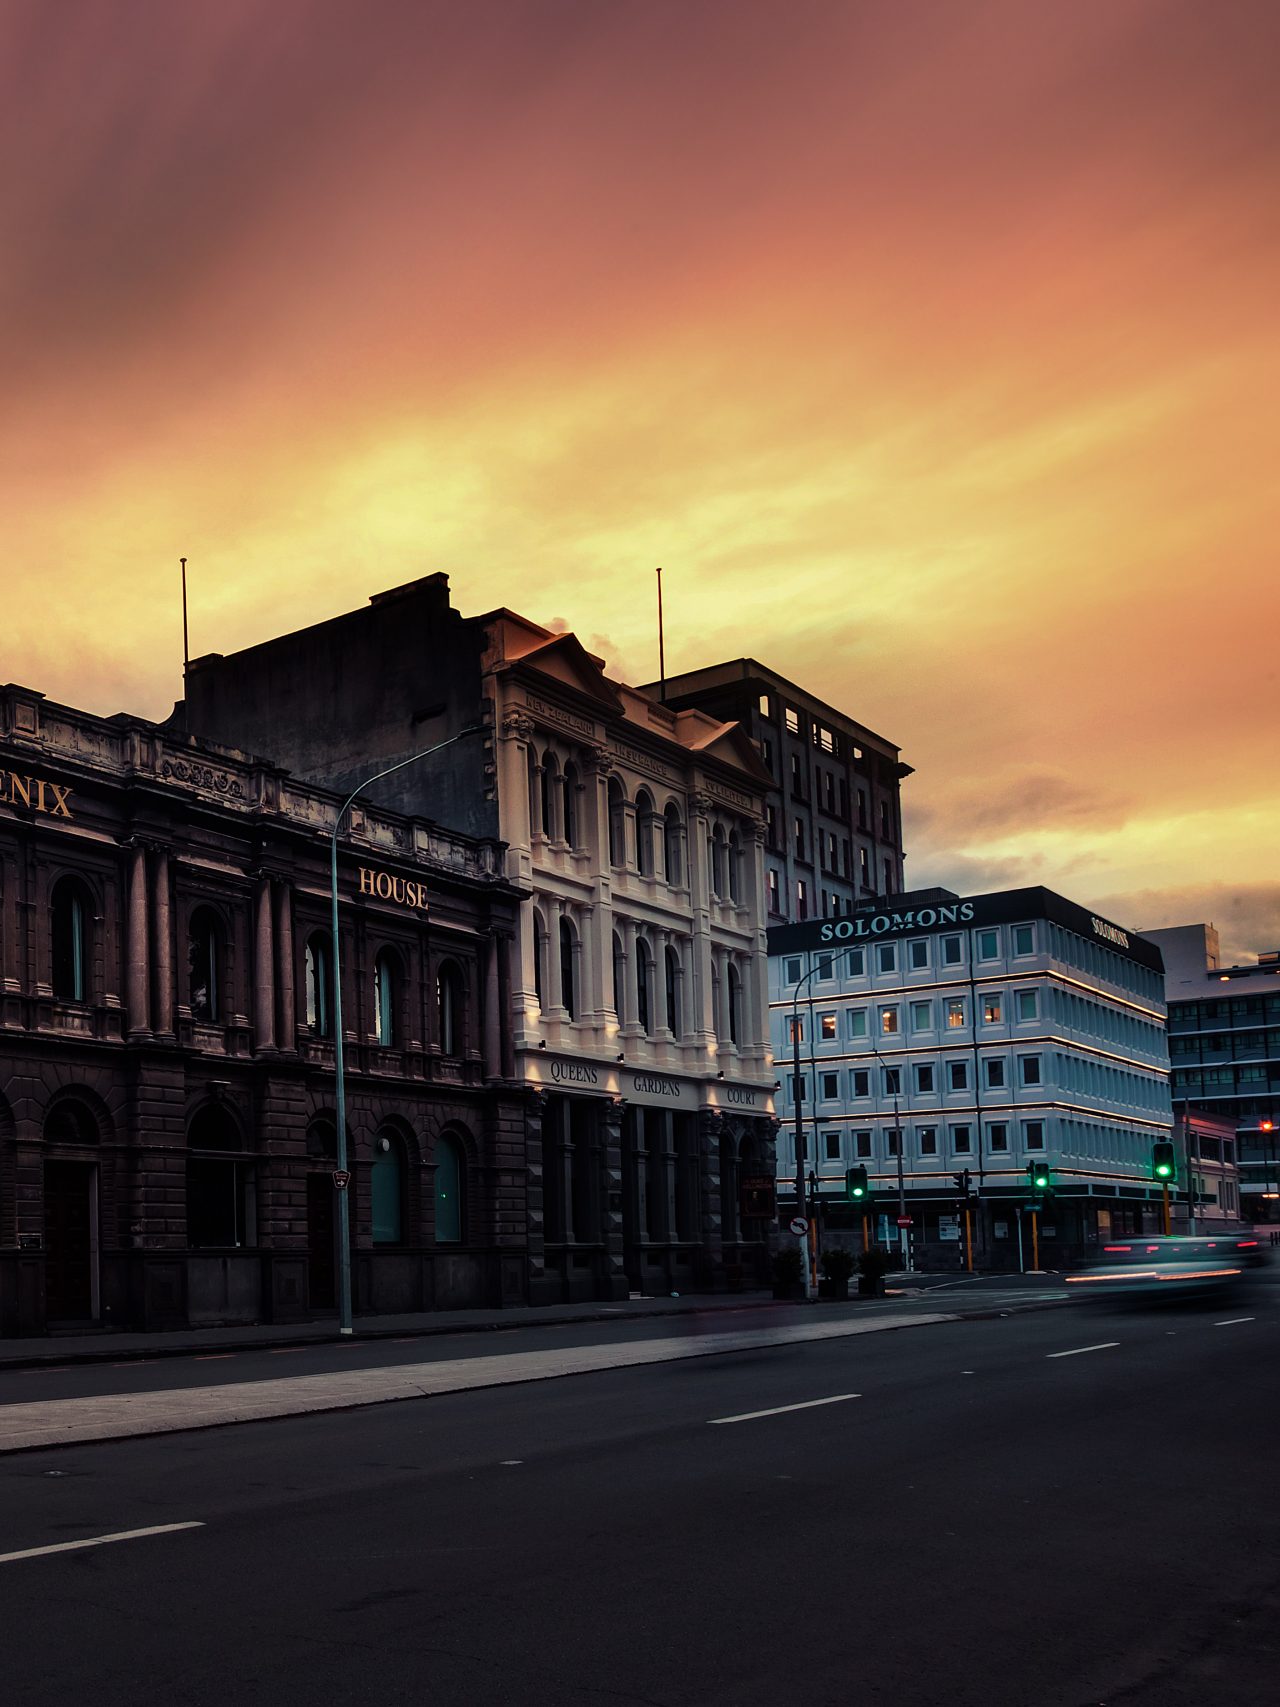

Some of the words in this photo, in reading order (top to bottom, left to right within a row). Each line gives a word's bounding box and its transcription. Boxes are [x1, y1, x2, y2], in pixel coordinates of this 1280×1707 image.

[358, 866, 430, 911] HOUSE
[819, 902, 975, 942] SOLOMONS
[1091, 916, 1130, 949] SOLOMONS
[550, 1060, 598, 1085] QUEENS
[633, 1075, 680, 1098] GARDENS
[727, 1087, 756, 1106] COURT
